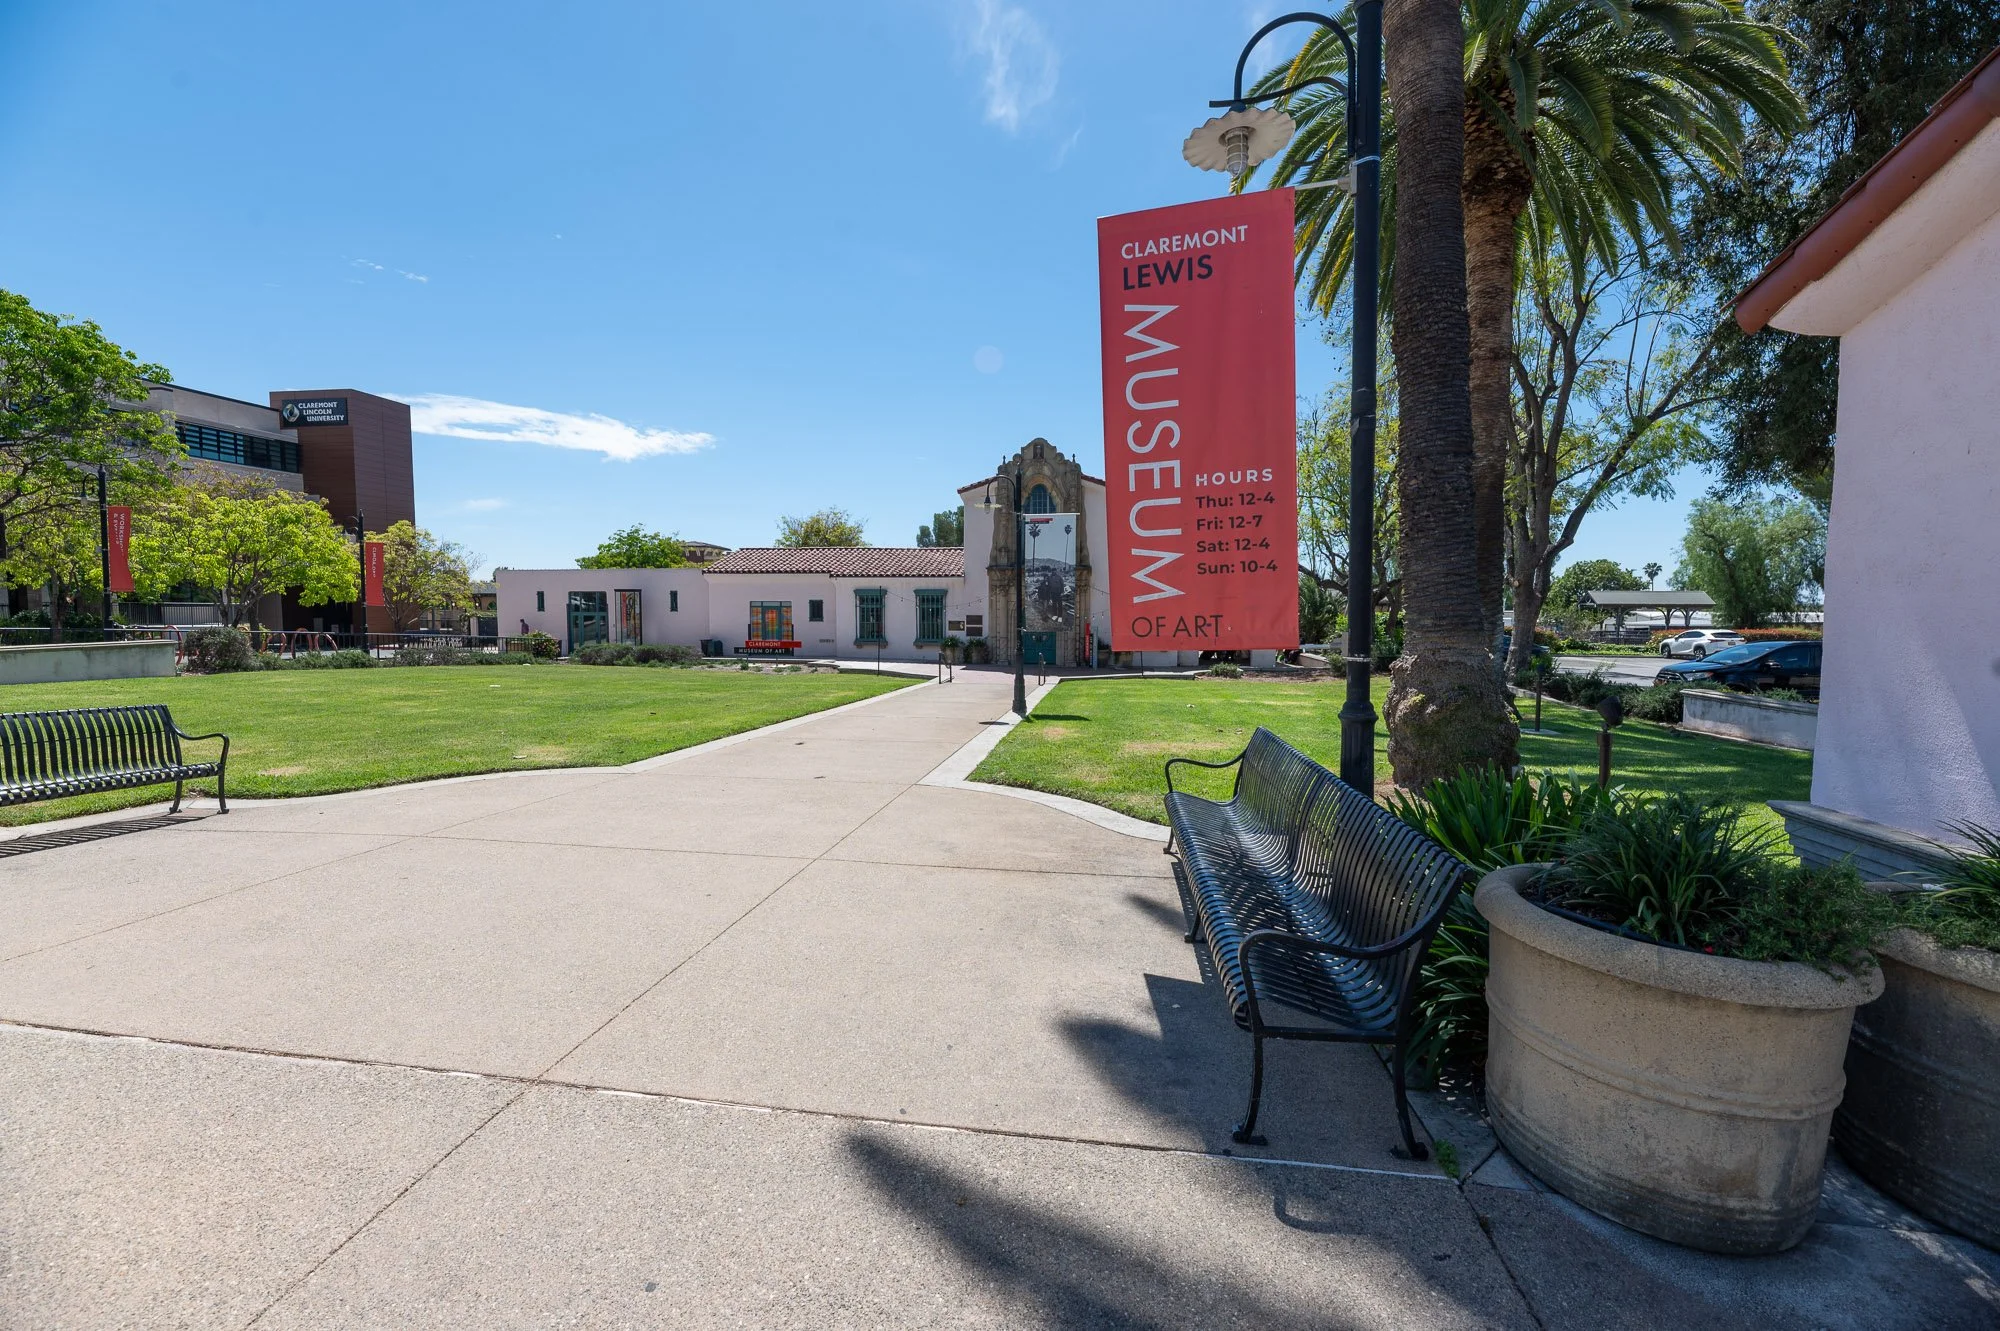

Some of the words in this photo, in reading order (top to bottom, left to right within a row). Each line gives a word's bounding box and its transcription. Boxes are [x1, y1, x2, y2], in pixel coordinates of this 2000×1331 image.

[1121, 224, 1249, 259] CLAREMONT
[1123, 254, 1214, 291] LEWIS
[298, 401, 338, 409] CLAREMONT
[1123, 304, 1187, 604] MUSEUM
[1196, 468, 1273, 487] HOURS
[1196, 496, 1234, 509] Thu:
[1239, 491, 1276, 506] 12-4
[1196, 517, 1224, 531] Fri:
[1229, 514, 1263, 529] 12-7
[1196, 540, 1230, 553] Sat:
[1234, 537, 1271, 551] 12-4
[1197, 562, 1235, 575] Sun:
[1240, 559, 1278, 573] 10-4
[1131, 616, 1166, 638] OF
[1172, 614, 1224, 638] ART
